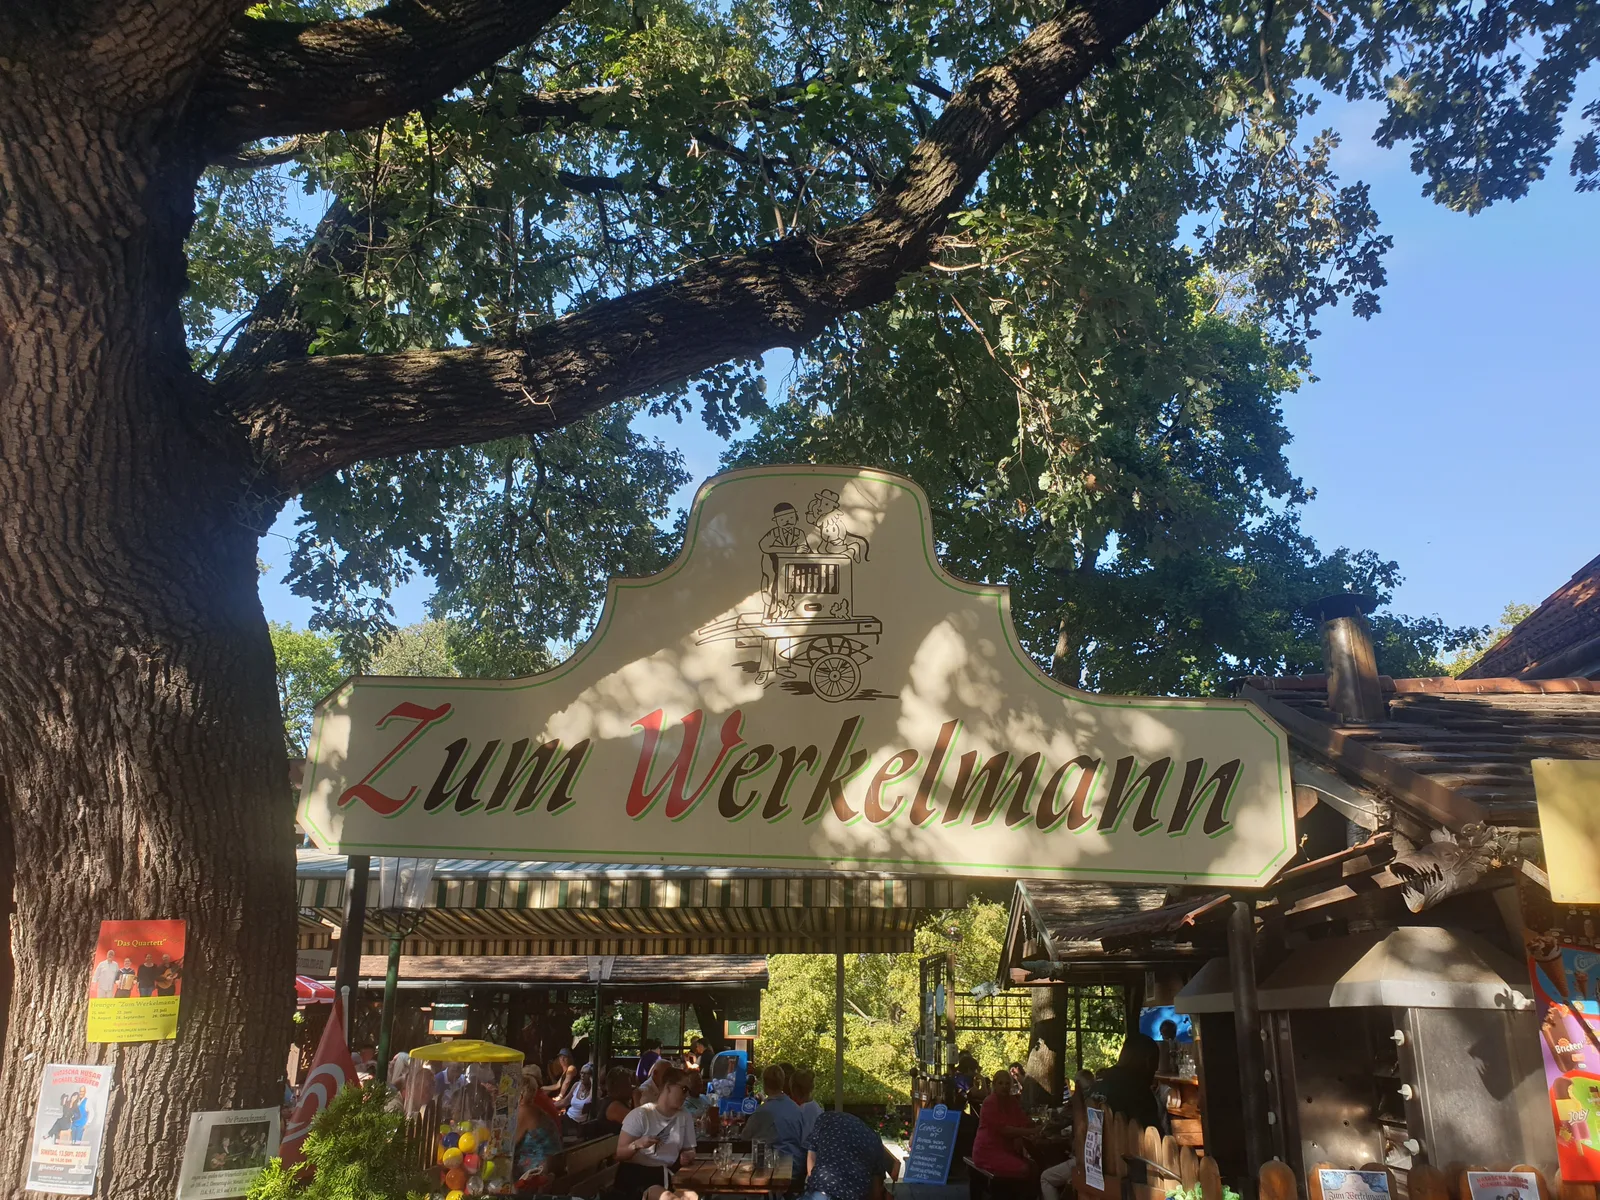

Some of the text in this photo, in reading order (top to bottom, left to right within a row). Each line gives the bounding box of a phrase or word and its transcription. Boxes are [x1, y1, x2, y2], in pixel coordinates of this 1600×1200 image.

[337, 701, 1241, 838] Zum Werkelmann
[1567, 1108, 1589, 1124] JOLLY
